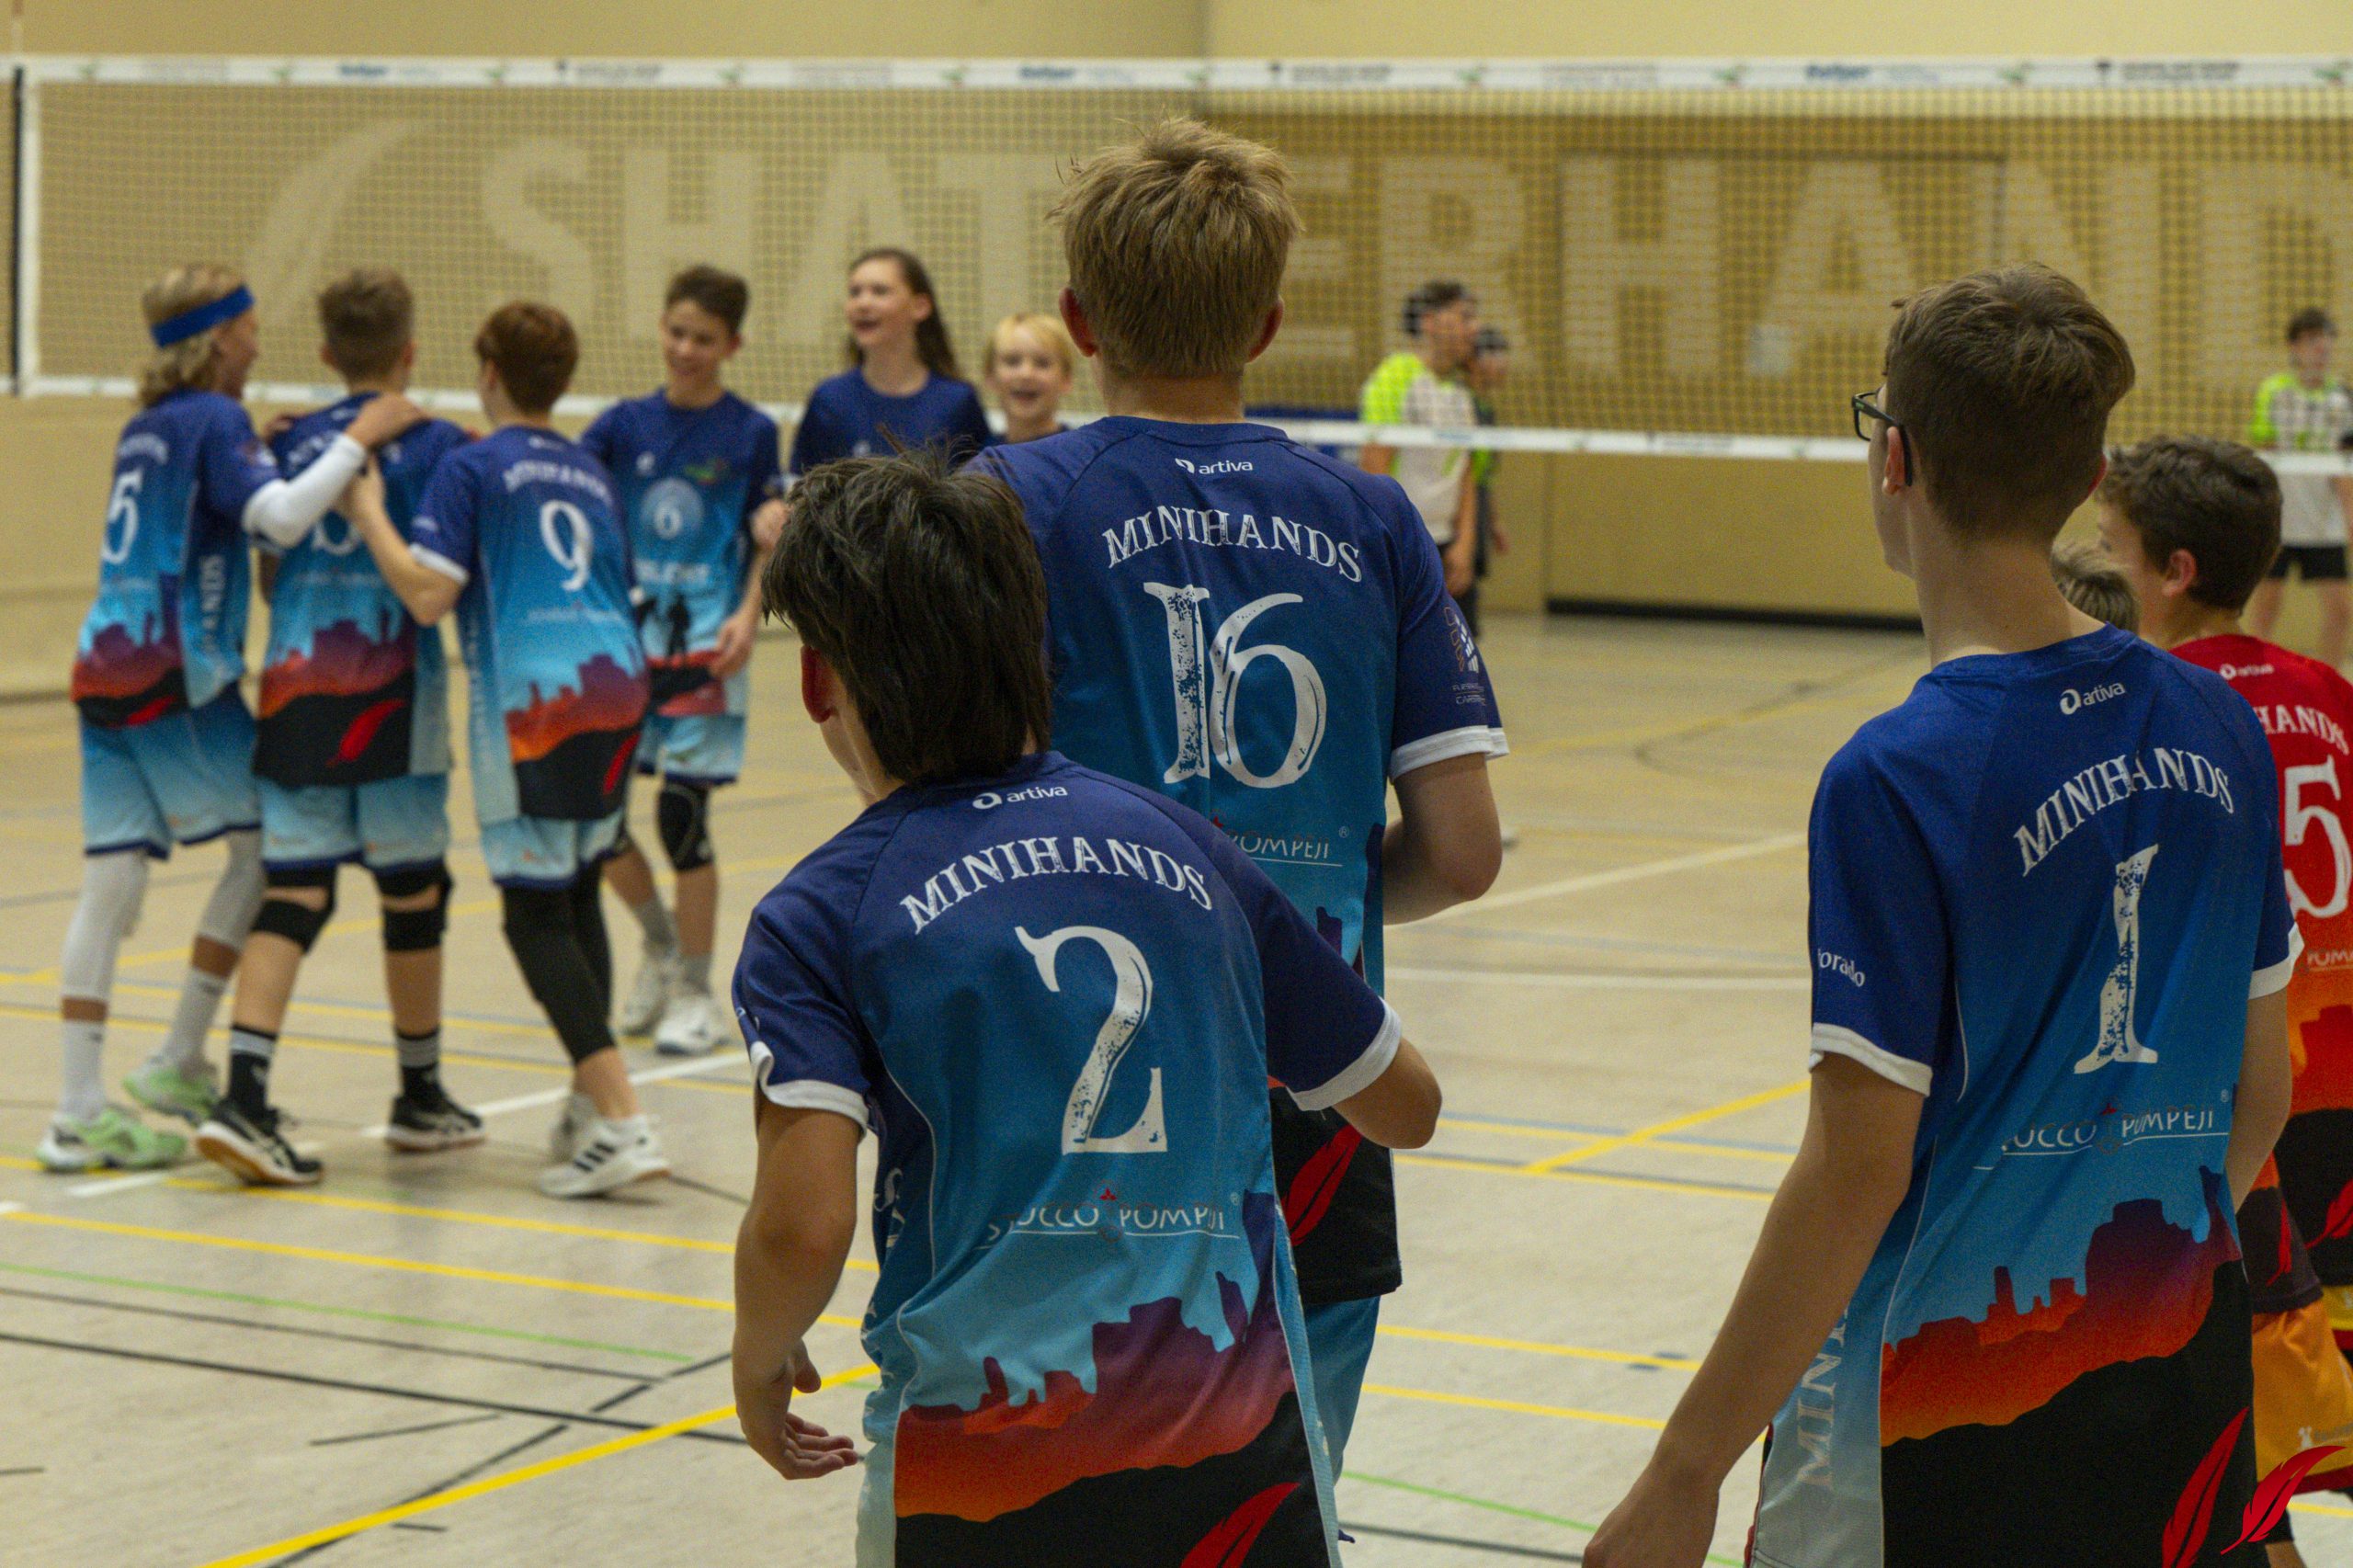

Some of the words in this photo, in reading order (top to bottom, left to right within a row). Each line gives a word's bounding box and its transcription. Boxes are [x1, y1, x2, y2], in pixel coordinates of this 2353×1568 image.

[483, 144, 2353, 377] SHATERHAND
[102, 467, 143, 563] 5
[1199, 459, 1253, 474] artiva
[540, 500, 593, 591] 9
[1102, 505, 1362, 583] MINIHANDS
[1143, 582, 1326, 789] 16
[2081, 679, 2125, 707] artiva
[1006, 785, 1067, 803] artiva
[2012, 746, 2234, 877] MINIHANDS
[2284, 754, 2352, 918] 5
[899, 836, 1213, 936] MINIHANDS
[2074, 843, 2159, 1074] 1
[1014, 926, 1168, 1155] 2
